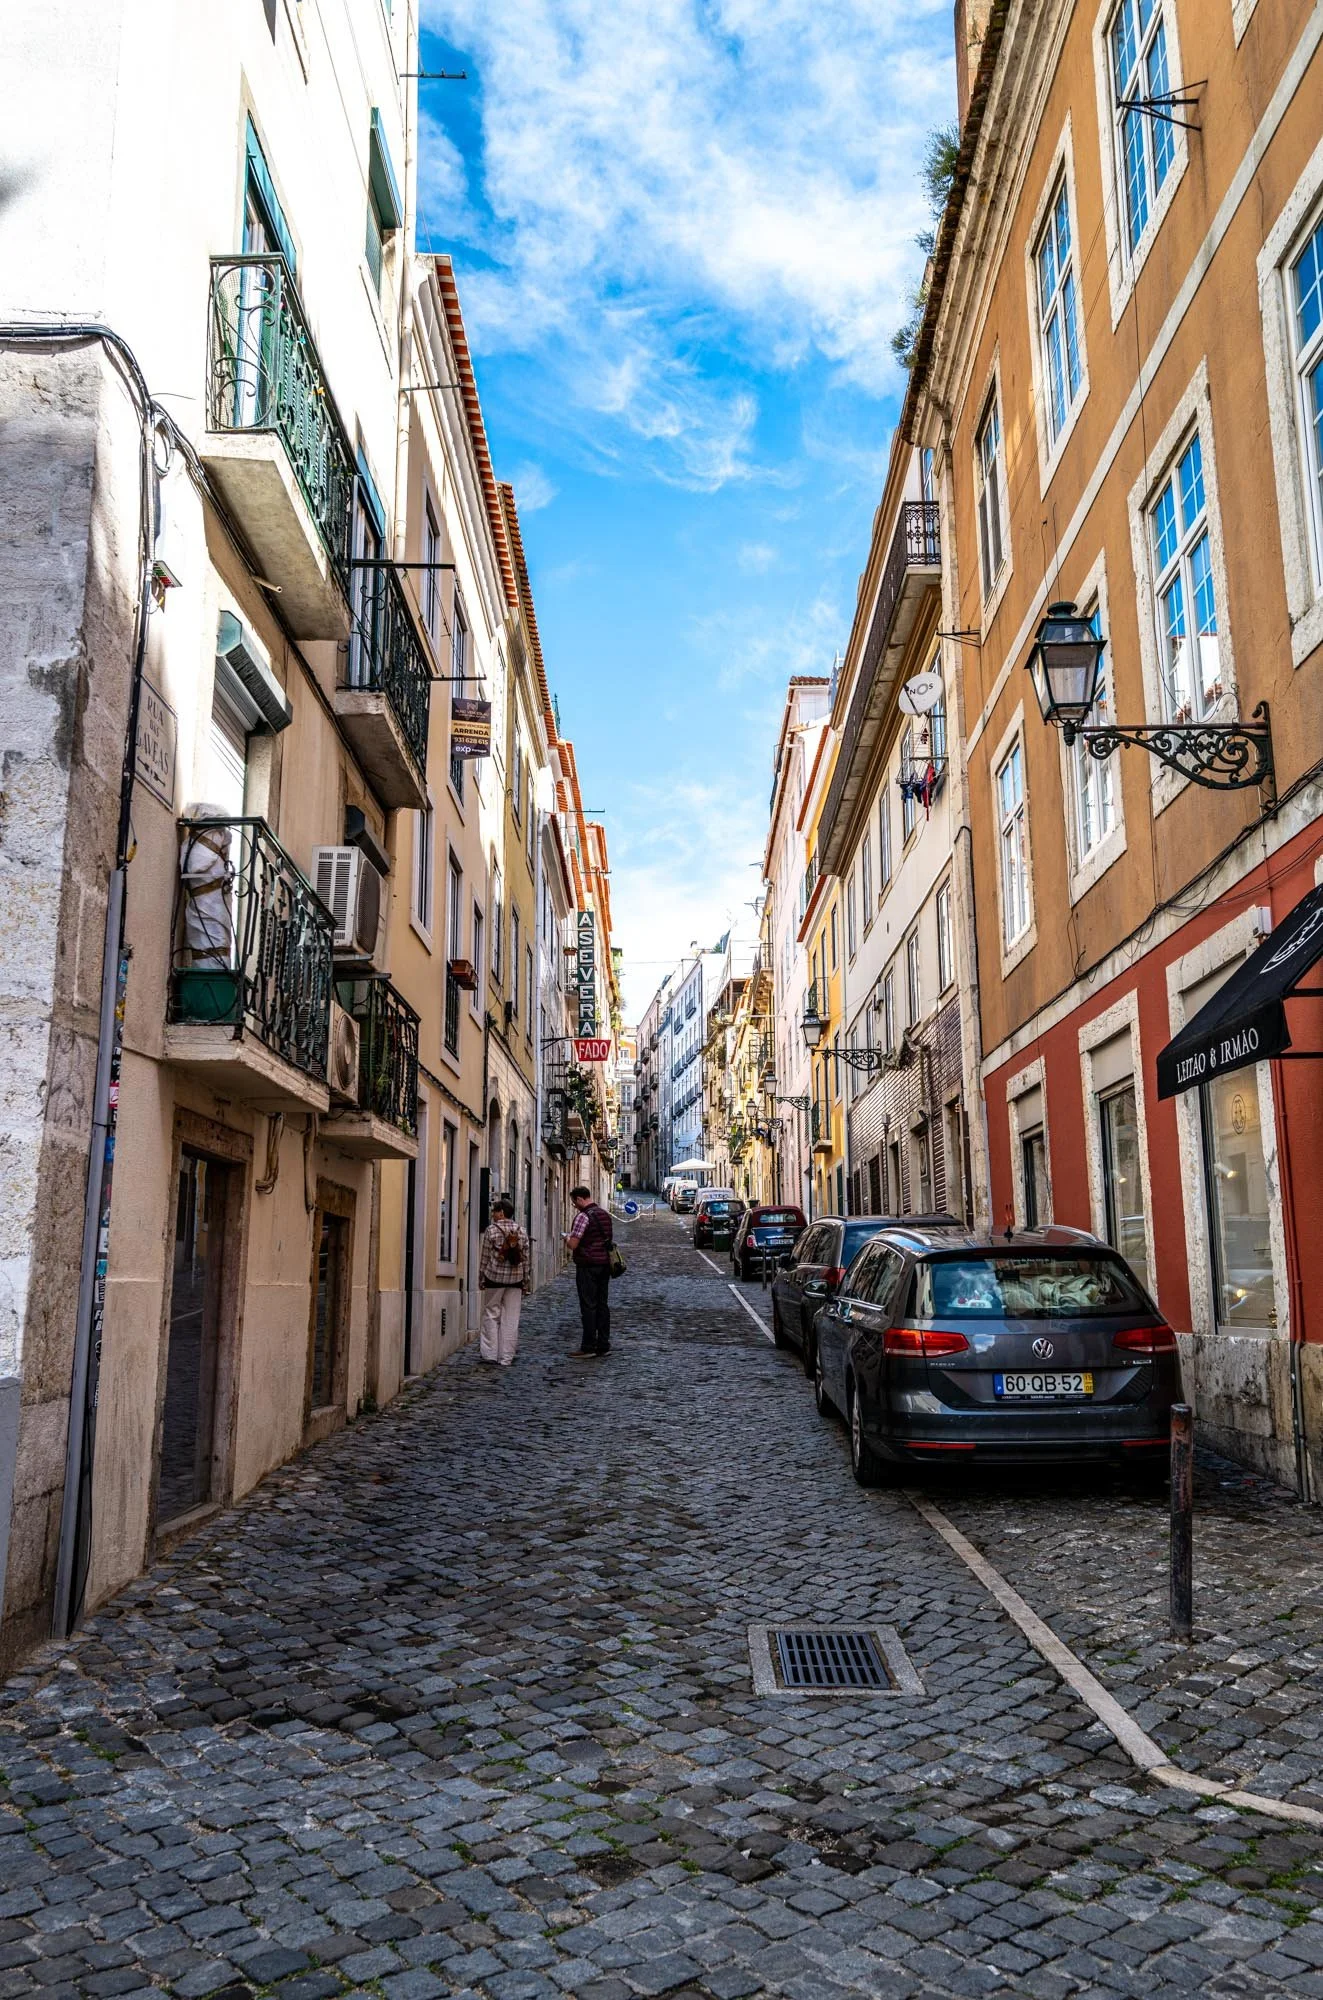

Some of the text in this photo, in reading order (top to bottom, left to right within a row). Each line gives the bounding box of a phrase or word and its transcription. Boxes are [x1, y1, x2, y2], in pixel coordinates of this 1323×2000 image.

[910, 683, 934, 695] NOS
[147, 695, 164, 727] RUA
[149, 719, 160, 738] DAS
[453, 727, 489, 736] ARRENDA
[455, 745, 471, 755] exp
[578, 1042, 608, 1059] FADO
[1176, 1027, 1259, 1084] LEITÃO & IRMÃO
